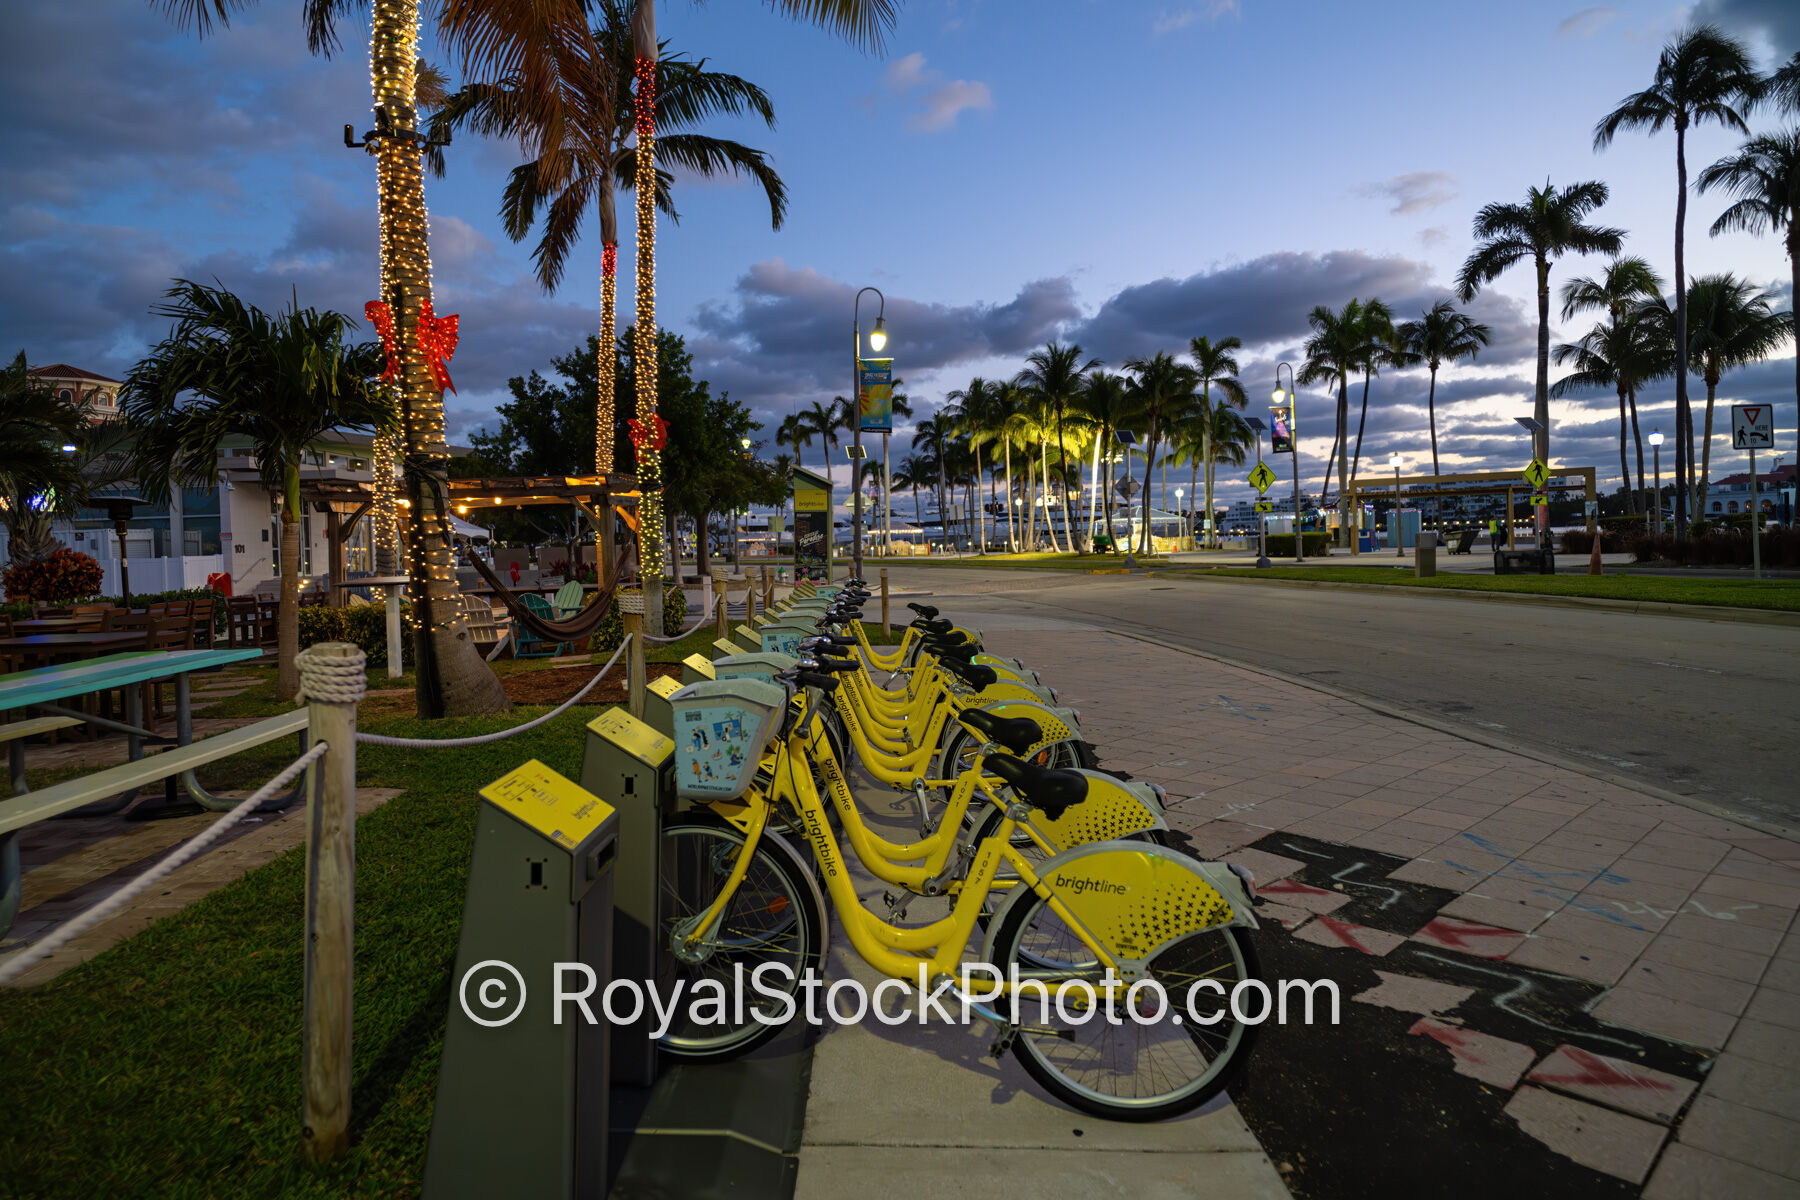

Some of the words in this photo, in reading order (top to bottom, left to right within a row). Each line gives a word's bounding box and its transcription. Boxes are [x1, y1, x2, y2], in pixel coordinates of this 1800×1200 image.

[234, 544, 245, 553] 101
[843, 674, 861, 707] brightbike
[837, 694, 857, 732] brightbike
[824, 758, 851, 811] brightbike
[805, 809, 837, 877] brightbike
[975, 851, 991, 884] 1057
[1056, 873, 1126, 895] brightline
[1115, 942, 1138, 951] DOWNTOWN
